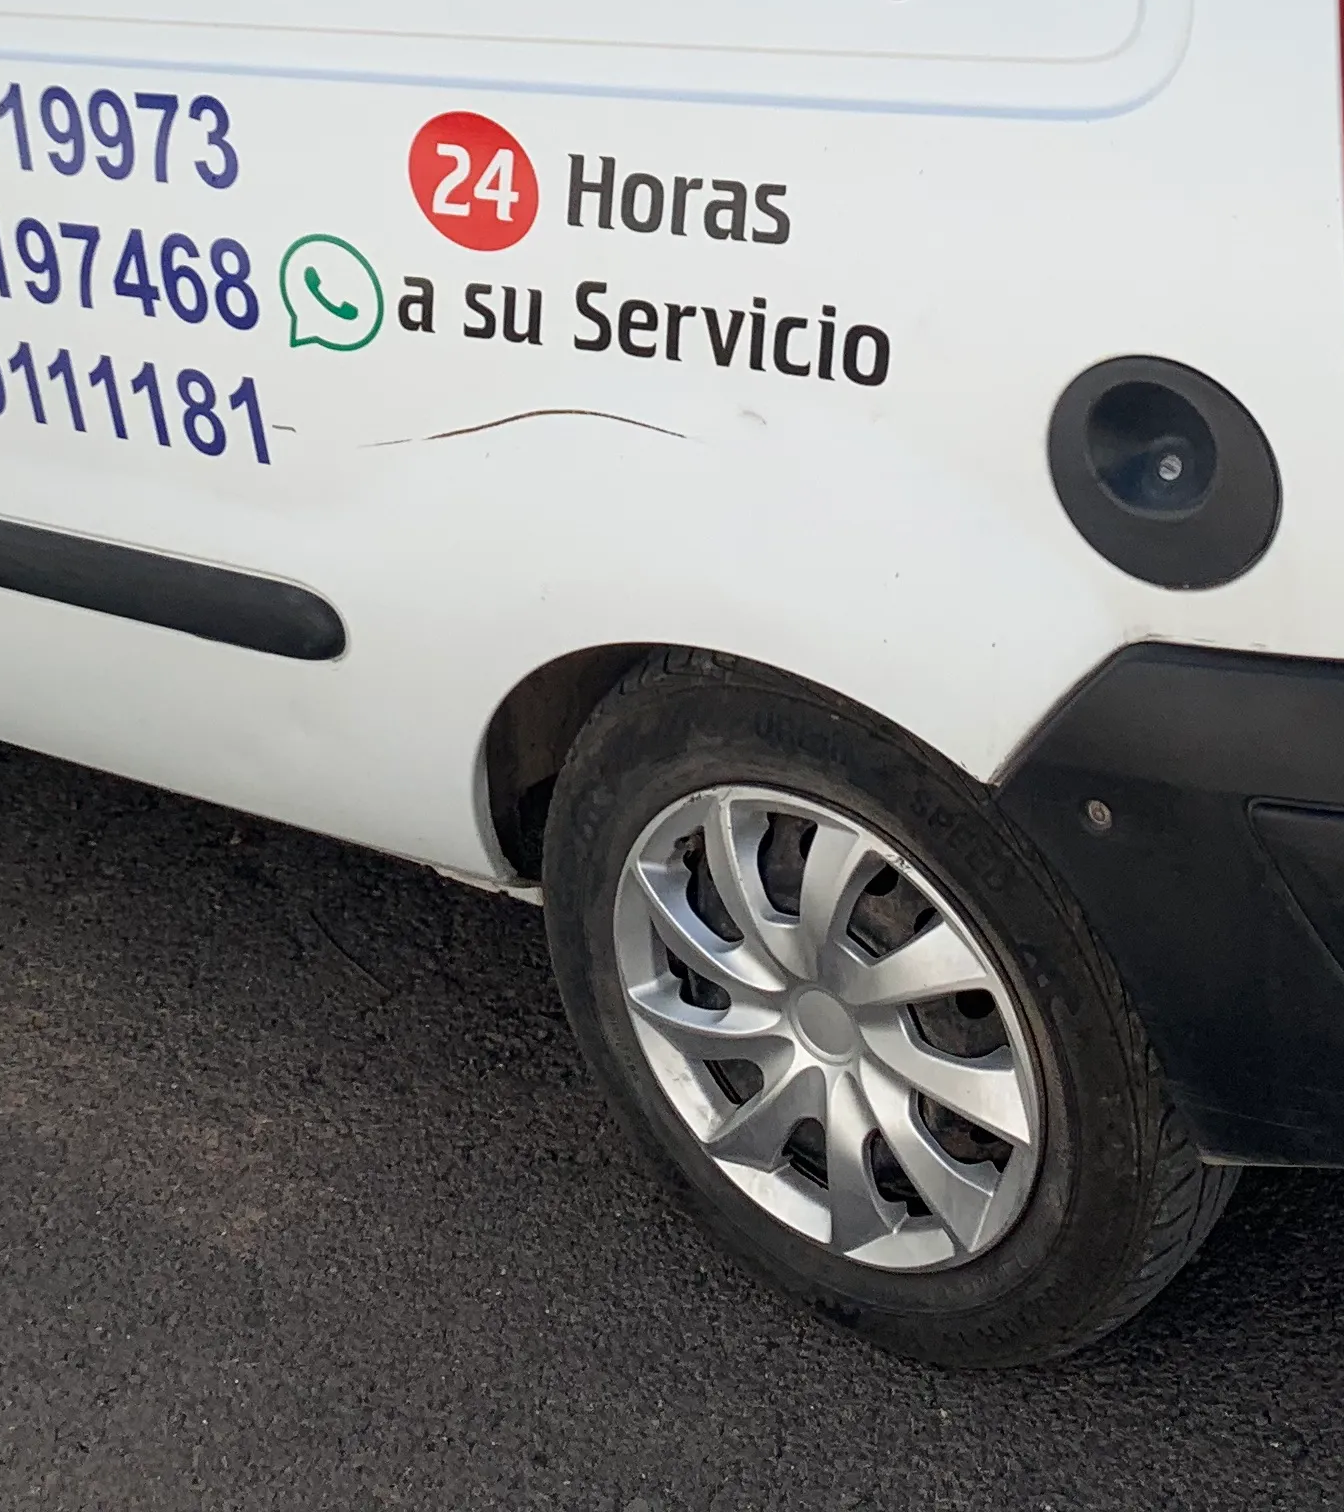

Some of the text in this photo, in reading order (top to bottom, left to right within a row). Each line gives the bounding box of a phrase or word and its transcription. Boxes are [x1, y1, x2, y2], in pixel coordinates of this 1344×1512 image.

[431, 140, 792, 245] 24 Horas
[397, 273, 892, 388] a su Servicio
